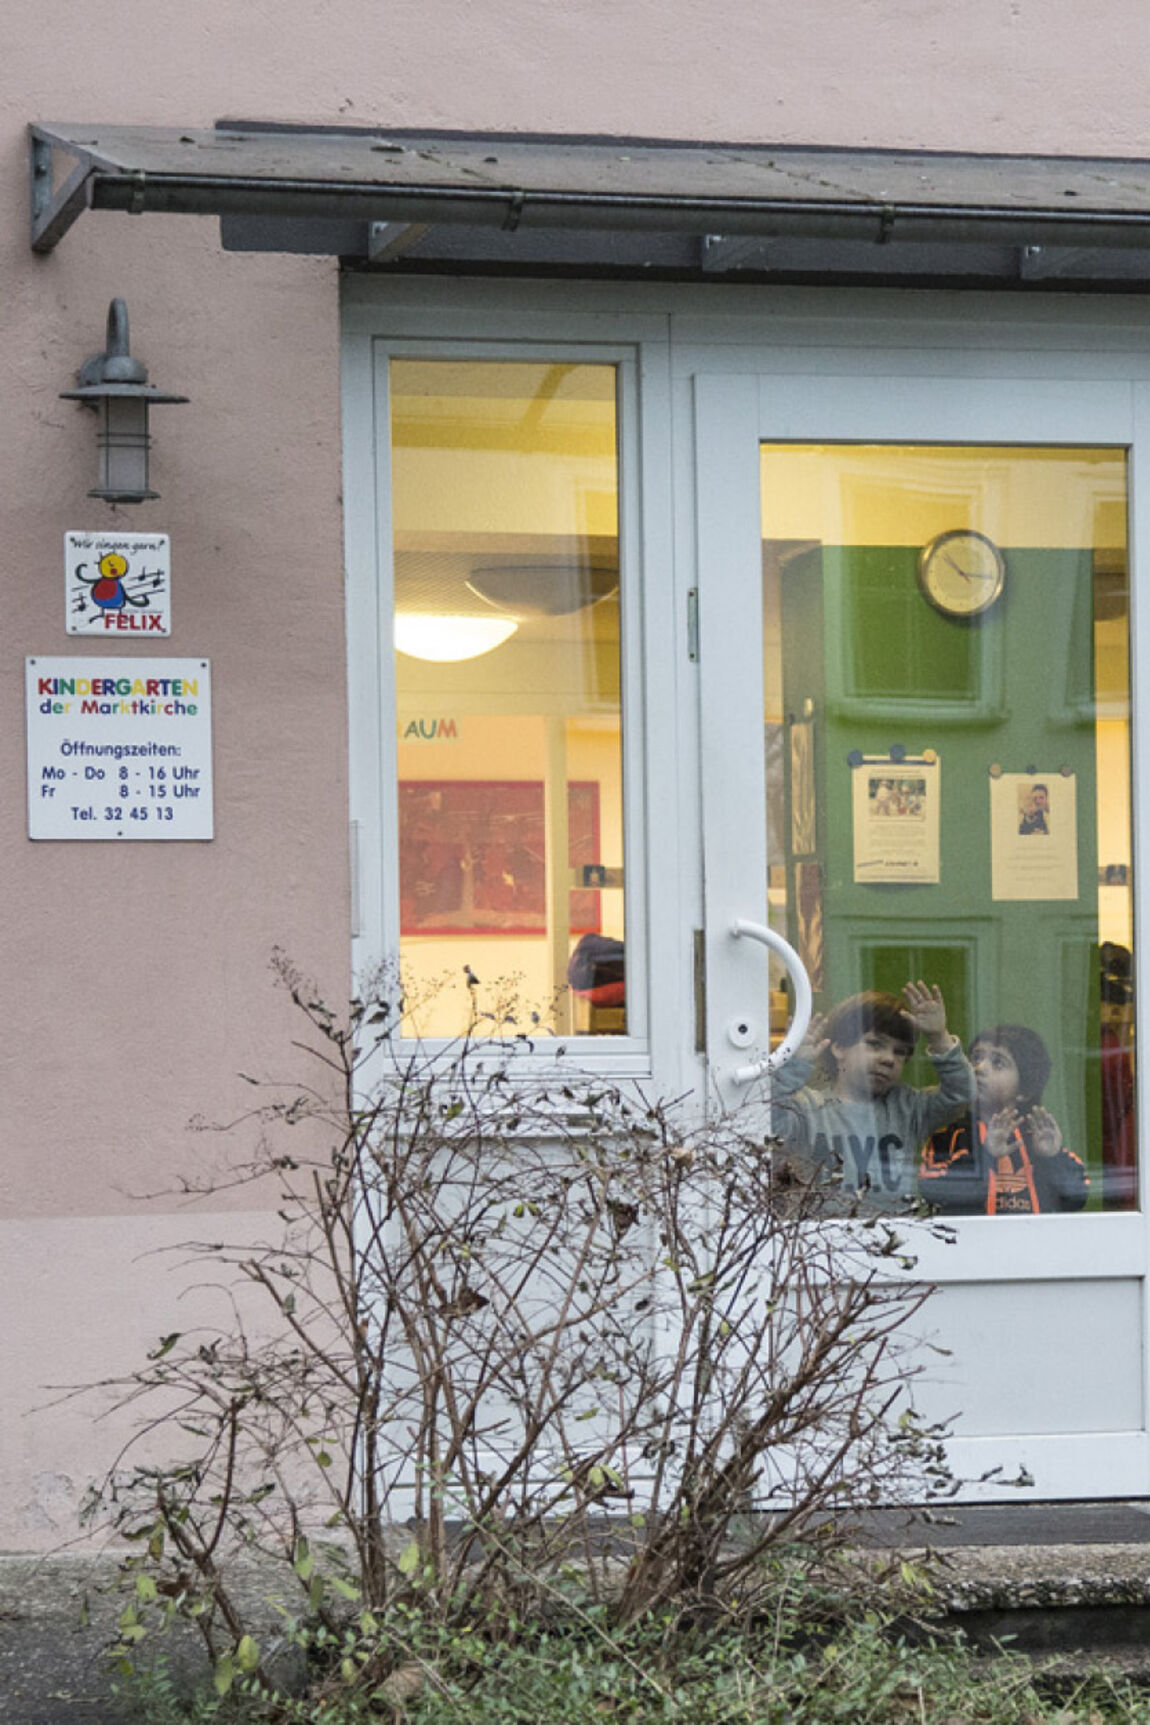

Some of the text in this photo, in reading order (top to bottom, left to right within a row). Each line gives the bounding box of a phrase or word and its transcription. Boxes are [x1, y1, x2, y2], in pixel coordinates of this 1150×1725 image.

[104, 612, 162, 631] FELIX
[38, 678, 198, 696] KINDERGARTEN
[39, 699, 198, 715] der Marktkirche
[60, 739, 182, 760] Öffnungszeiten:
[42, 766, 66, 780] Mo
[84, 766, 106, 780] Do
[118, 766, 129, 780] 8
[149, 766, 167, 780] 16
[172, 766, 200, 780] Uhr
[41, 785, 56, 798] Fr
[119, 785, 129, 798] 8
[149, 785, 167, 798] 15
[173, 785, 200, 798] Uhr
[71, 806, 174, 821] Tel. 32 45 13
